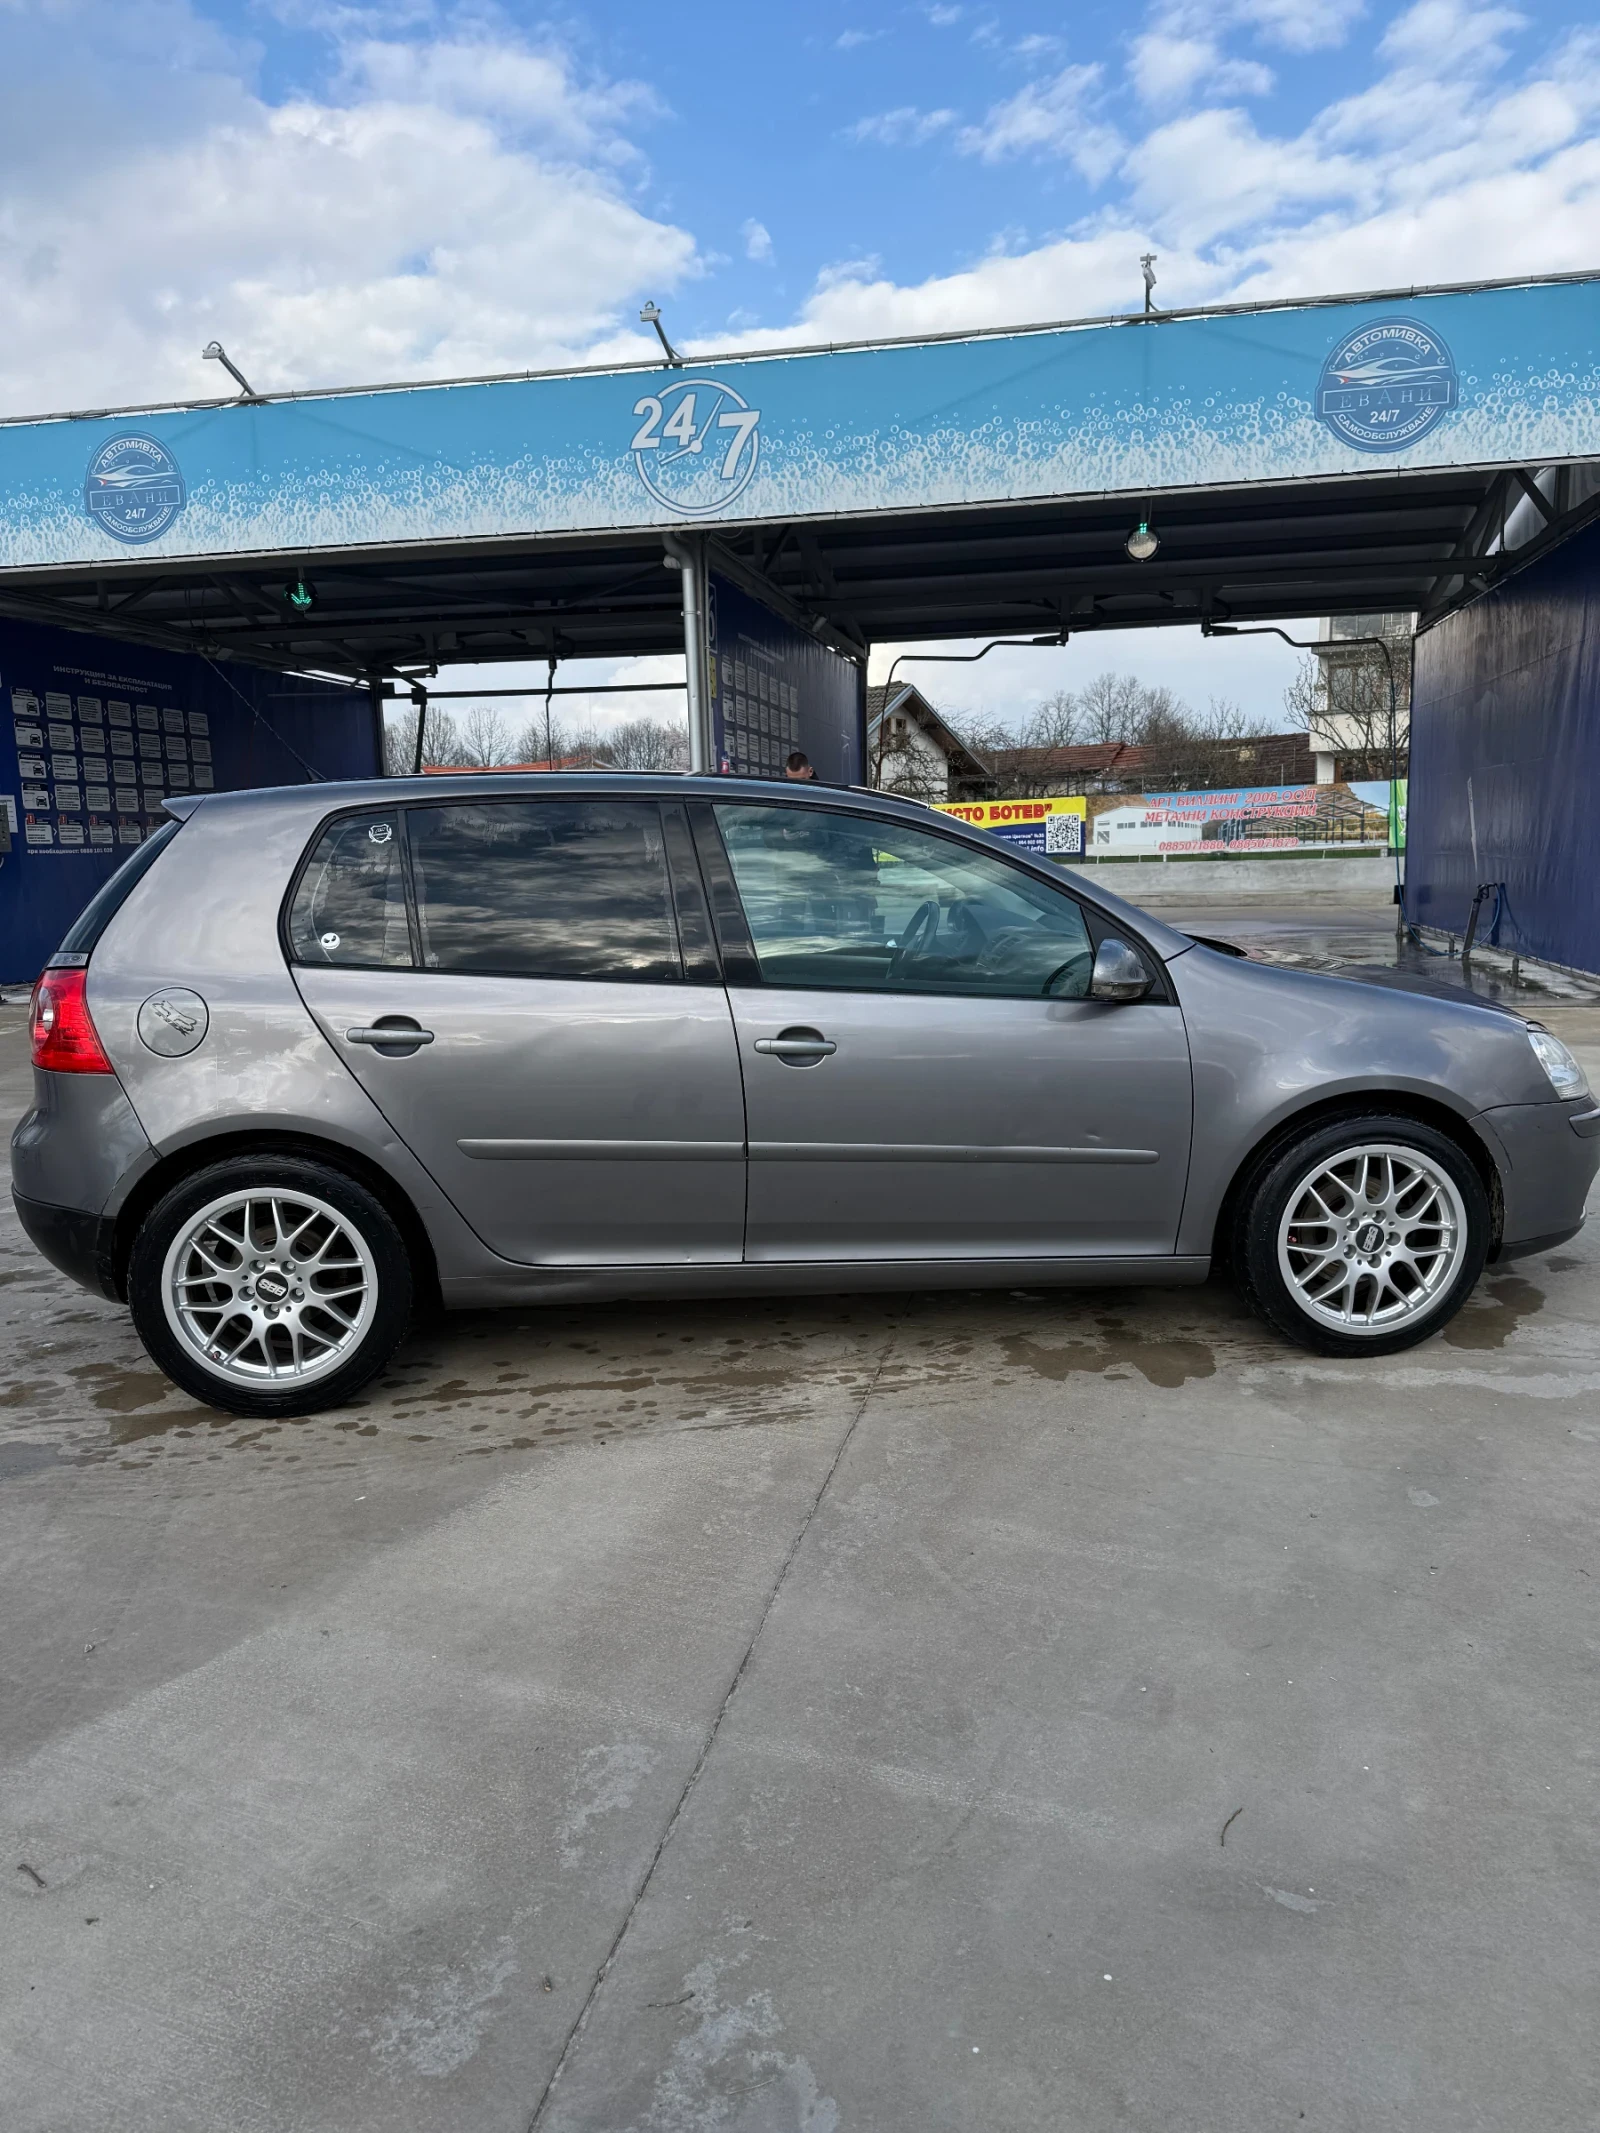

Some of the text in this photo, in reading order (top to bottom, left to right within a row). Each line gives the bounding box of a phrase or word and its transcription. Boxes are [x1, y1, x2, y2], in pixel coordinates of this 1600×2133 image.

[1344, 328, 1432, 363] АВТОМИВКА
[1340, 388, 1432, 408] ЕВАНИ
[1338, 405, 1434, 440] САМООБСЛУЖВАНЕ
[1369, 409, 1400, 424] 24/7
[100, 441, 162, 468] АВТОМИВКА
[102, 491, 168, 506] ЕВАНИ
[102, 506, 170, 533] САМООБСЛУЖВАНЕ
[125, 508, 147, 519] 24/7
[53, 665, 106, 679] ИНСТРУКЦИЯ
[118, 675, 173, 690] ЕКСПЛОАТАЦИЯ
[1149, 789, 1316, 808] АРТ БИЛДИНГ 2008 ООД
[1144, 804, 1318, 822] МЕТАЛНИ КОНСТРУКЦИИ
